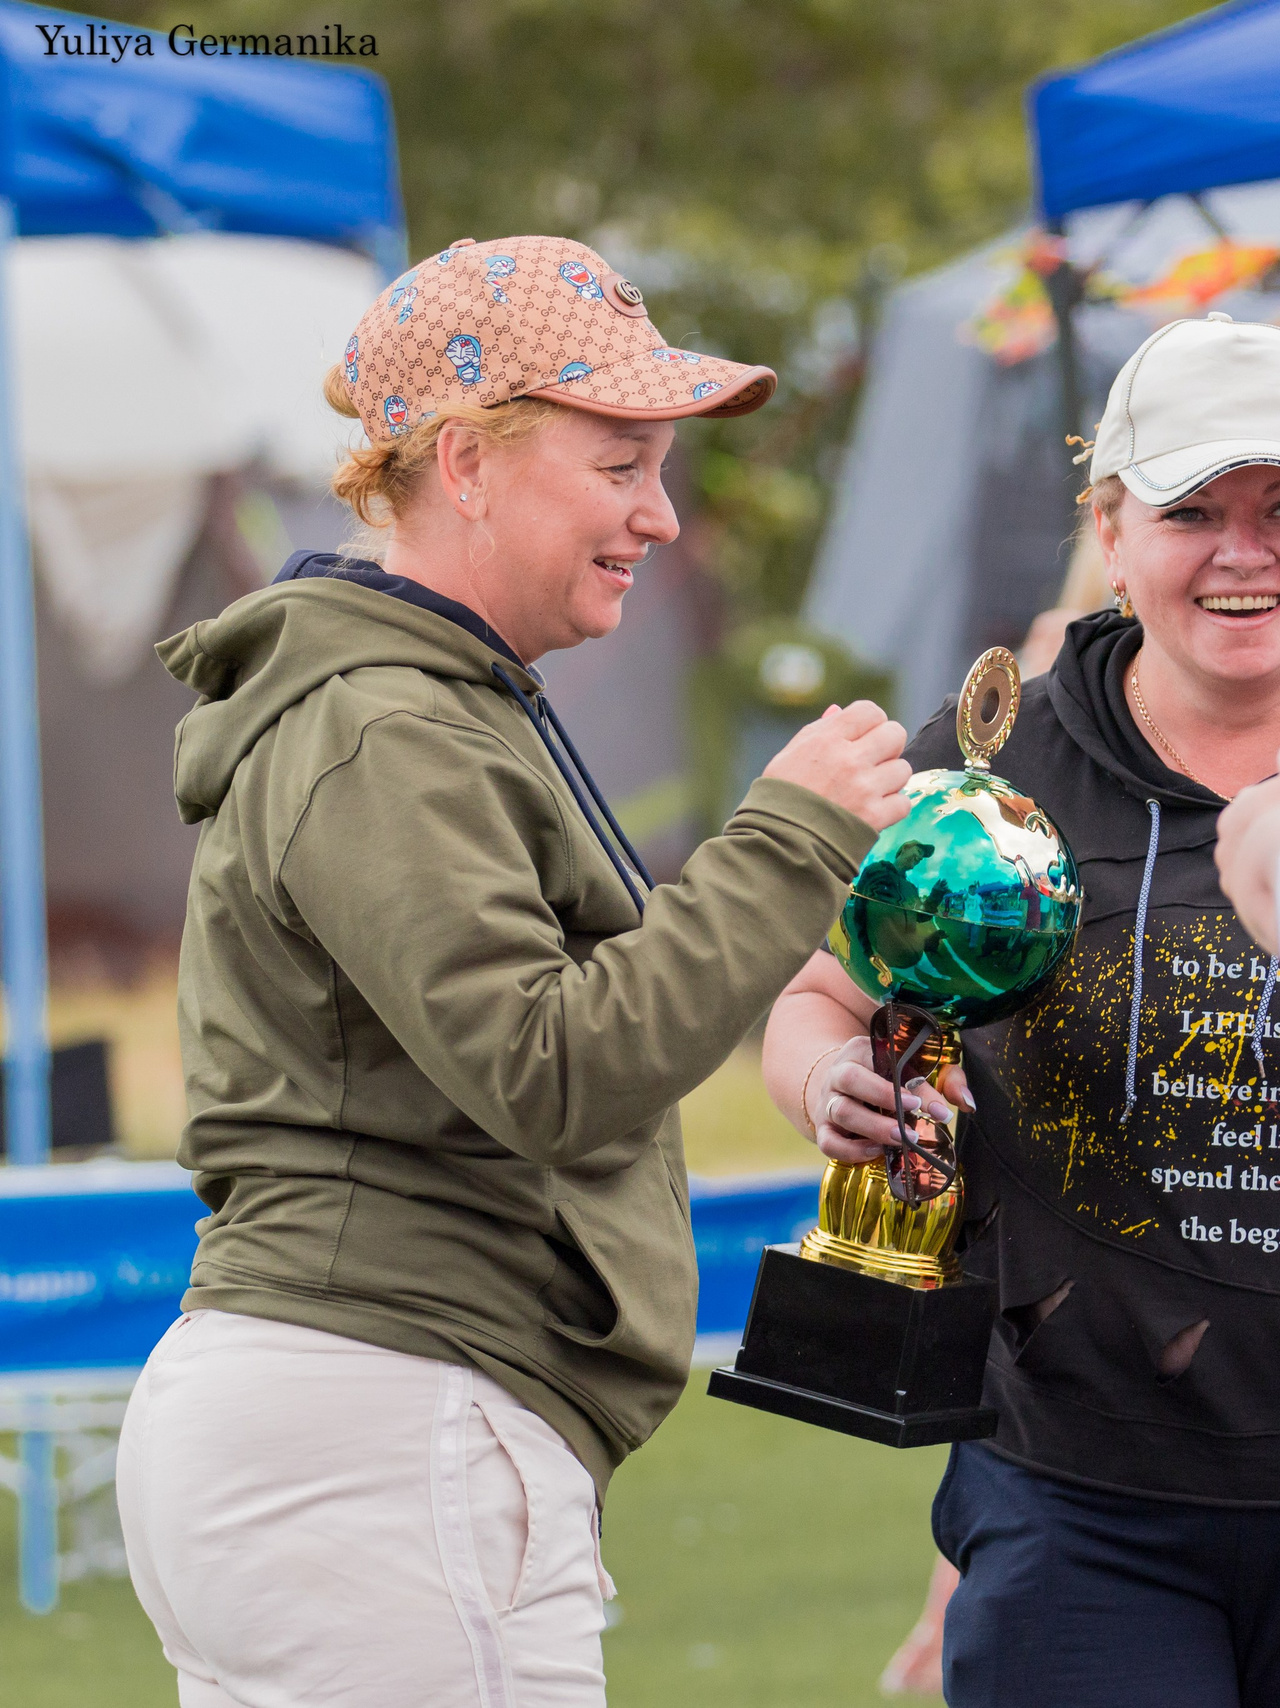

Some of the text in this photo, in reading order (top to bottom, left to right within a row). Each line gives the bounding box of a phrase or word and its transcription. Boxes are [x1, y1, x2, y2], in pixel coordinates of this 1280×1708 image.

[1172, 955, 1201, 978] to
[1208, 953, 1243, 979] be
[1180, 1010, 1255, 1037] LIFE
[1152, 1071, 1252, 1101] believe
[1211, 1121, 1262, 1148] feel
[1151, 1164, 1233, 1192] spend
[1180, 1215, 1223, 1242] the
